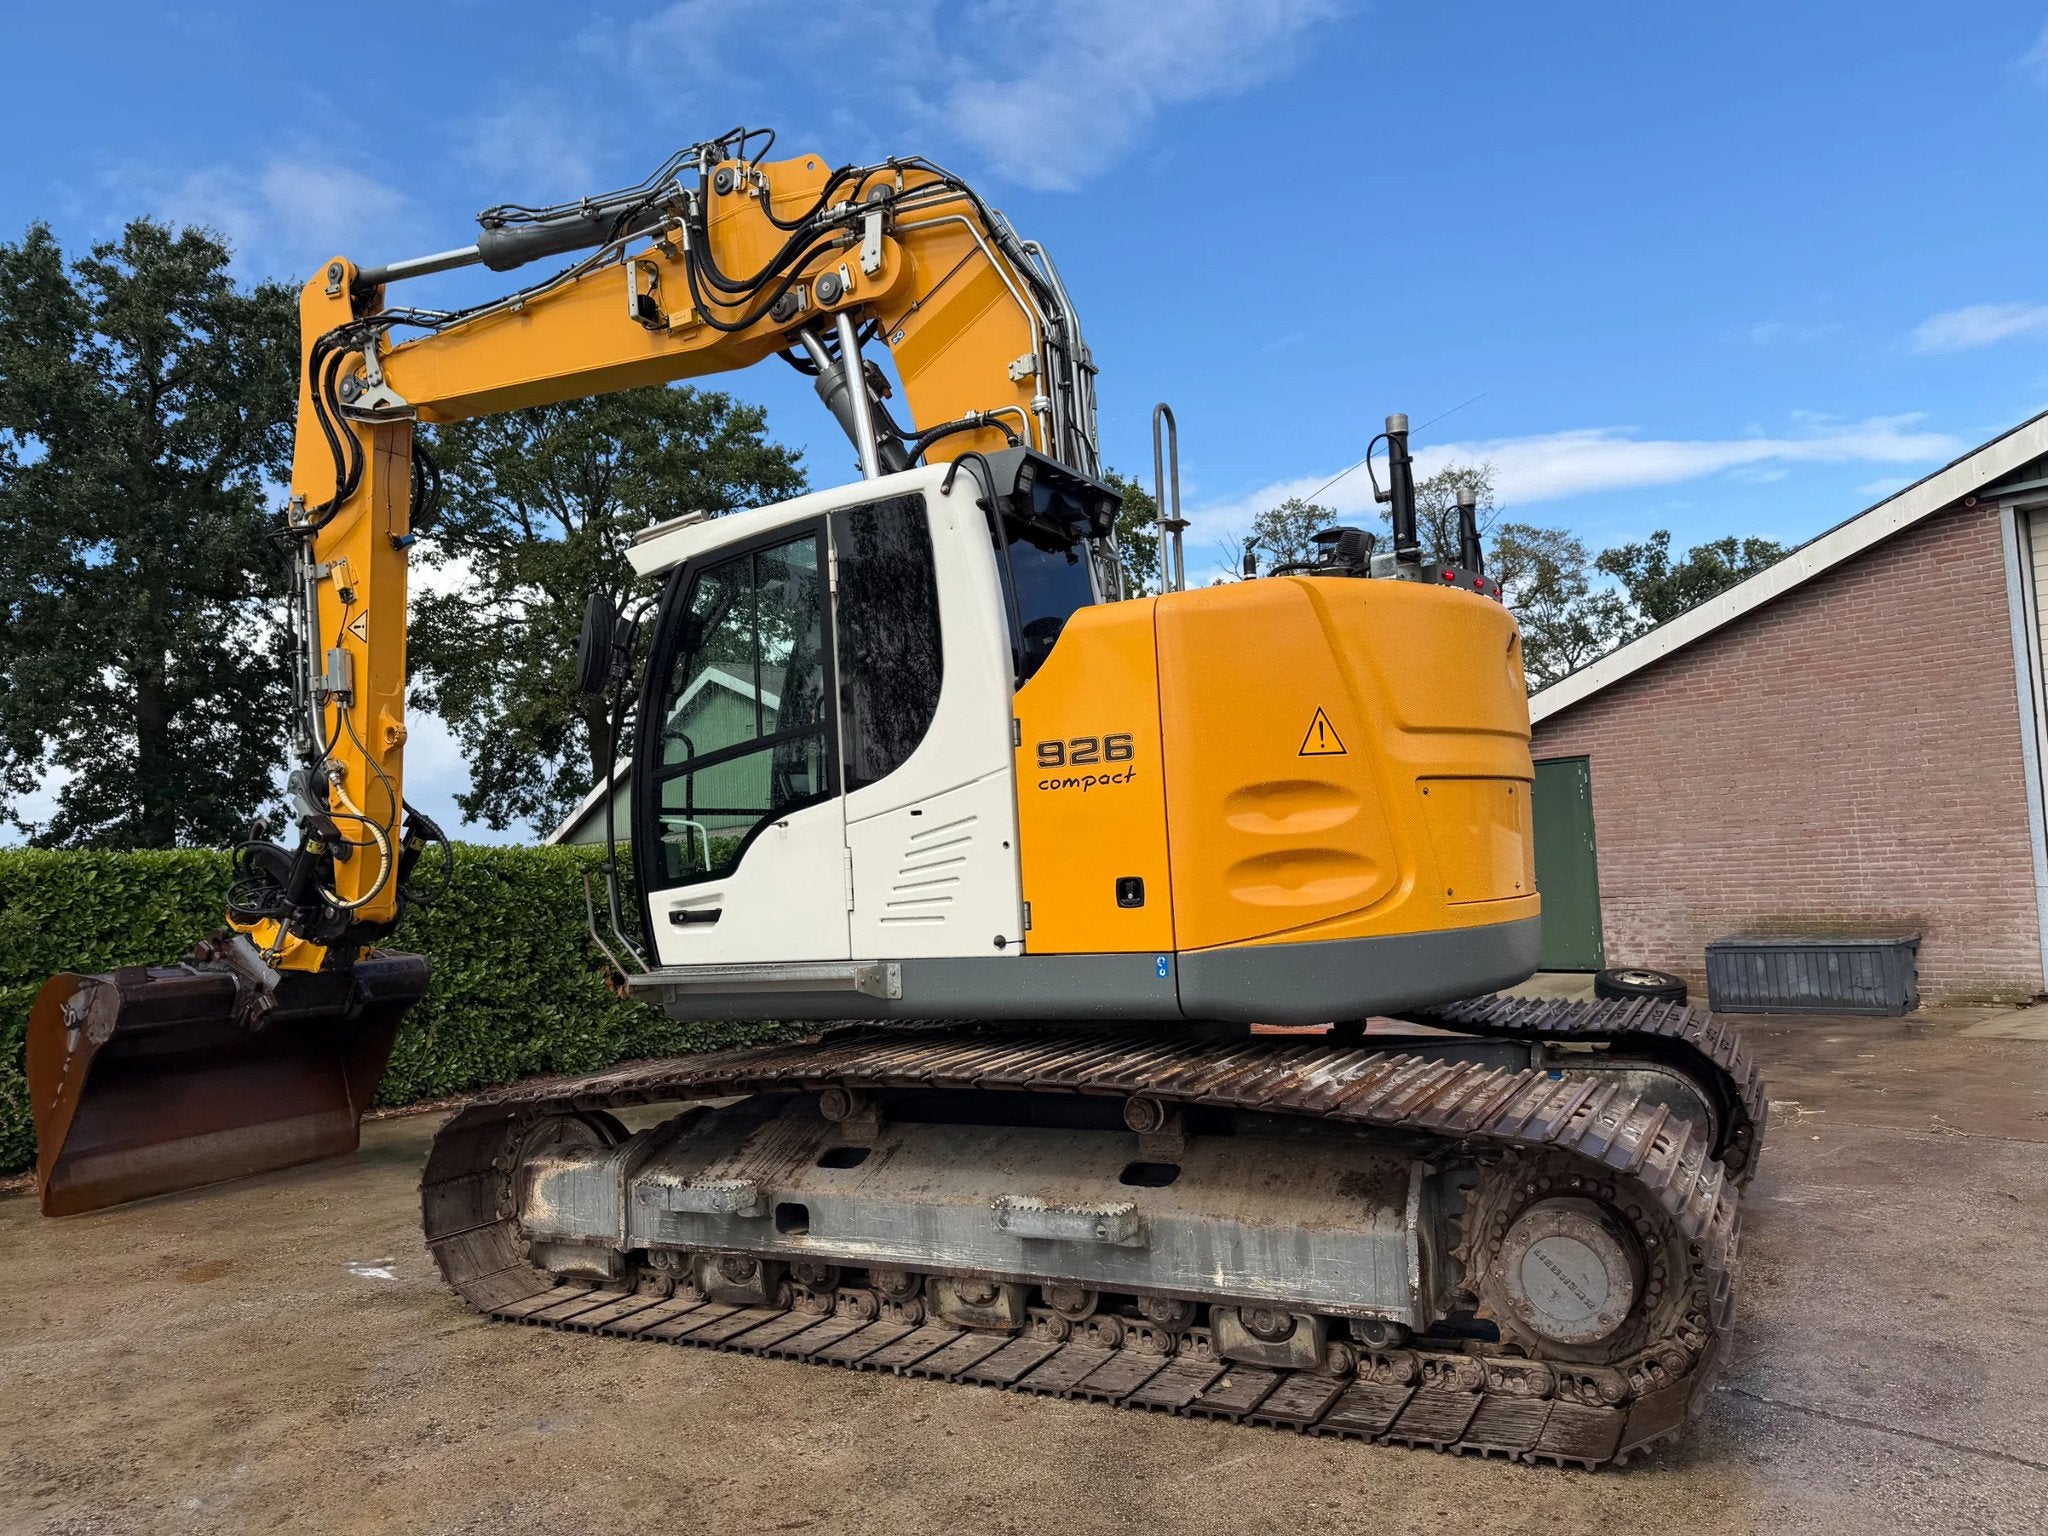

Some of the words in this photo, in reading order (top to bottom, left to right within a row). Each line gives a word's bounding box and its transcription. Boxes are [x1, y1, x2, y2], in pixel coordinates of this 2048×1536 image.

[1036, 733, 1134, 769] 926
[1038, 765, 1136, 792] compact
[1533, 1248, 1595, 1310] LIEBHERR
